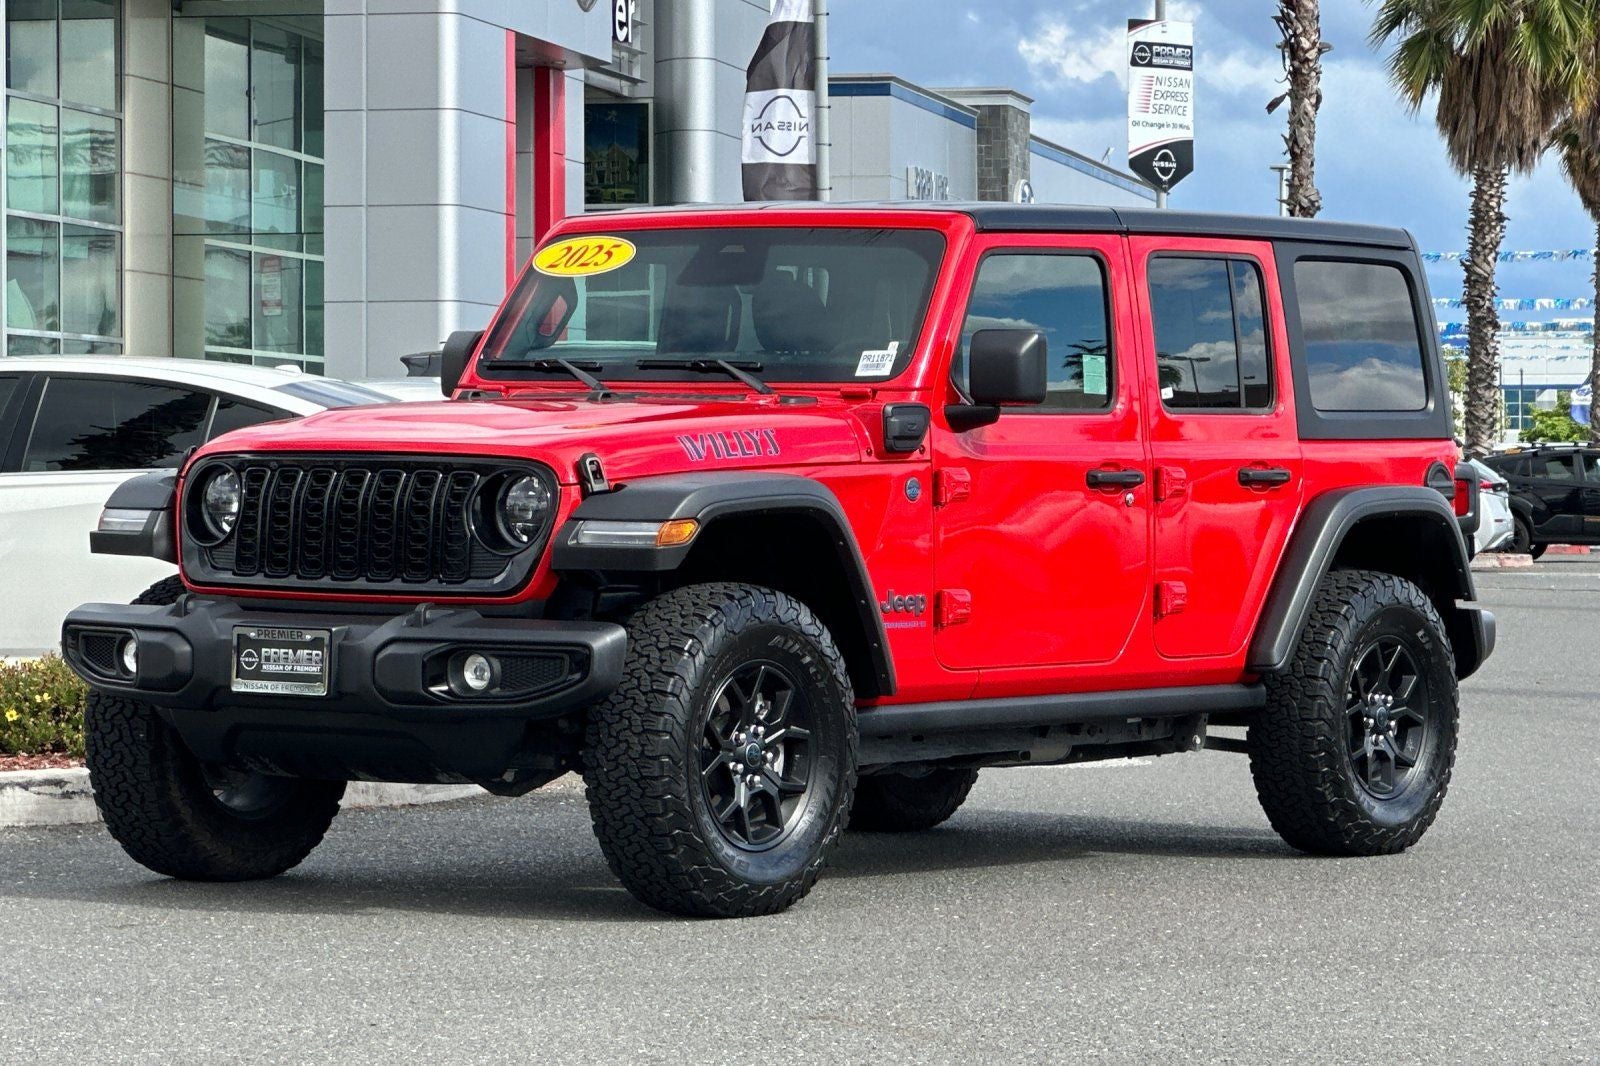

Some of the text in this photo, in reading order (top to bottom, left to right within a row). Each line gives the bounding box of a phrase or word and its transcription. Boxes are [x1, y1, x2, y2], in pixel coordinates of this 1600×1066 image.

[1152, 45, 1191, 59] PREMIER
[1155, 75, 1190, 88] NISSAN
[1153, 89, 1189, 103] EXPRESS
[1151, 103, 1187, 116] SERVICE
[1141, 120, 1165, 130] Change
[545, 244, 623, 269] 2025
[676, 427, 781, 461] WILLYS
[880, 589, 927, 617] Jeep
[256, 629, 303, 639] PREMIER
[261, 648, 322, 664] PREMIER
[293, 665, 321, 673] FREMONT
[243, 682, 269, 691] NISSAN
